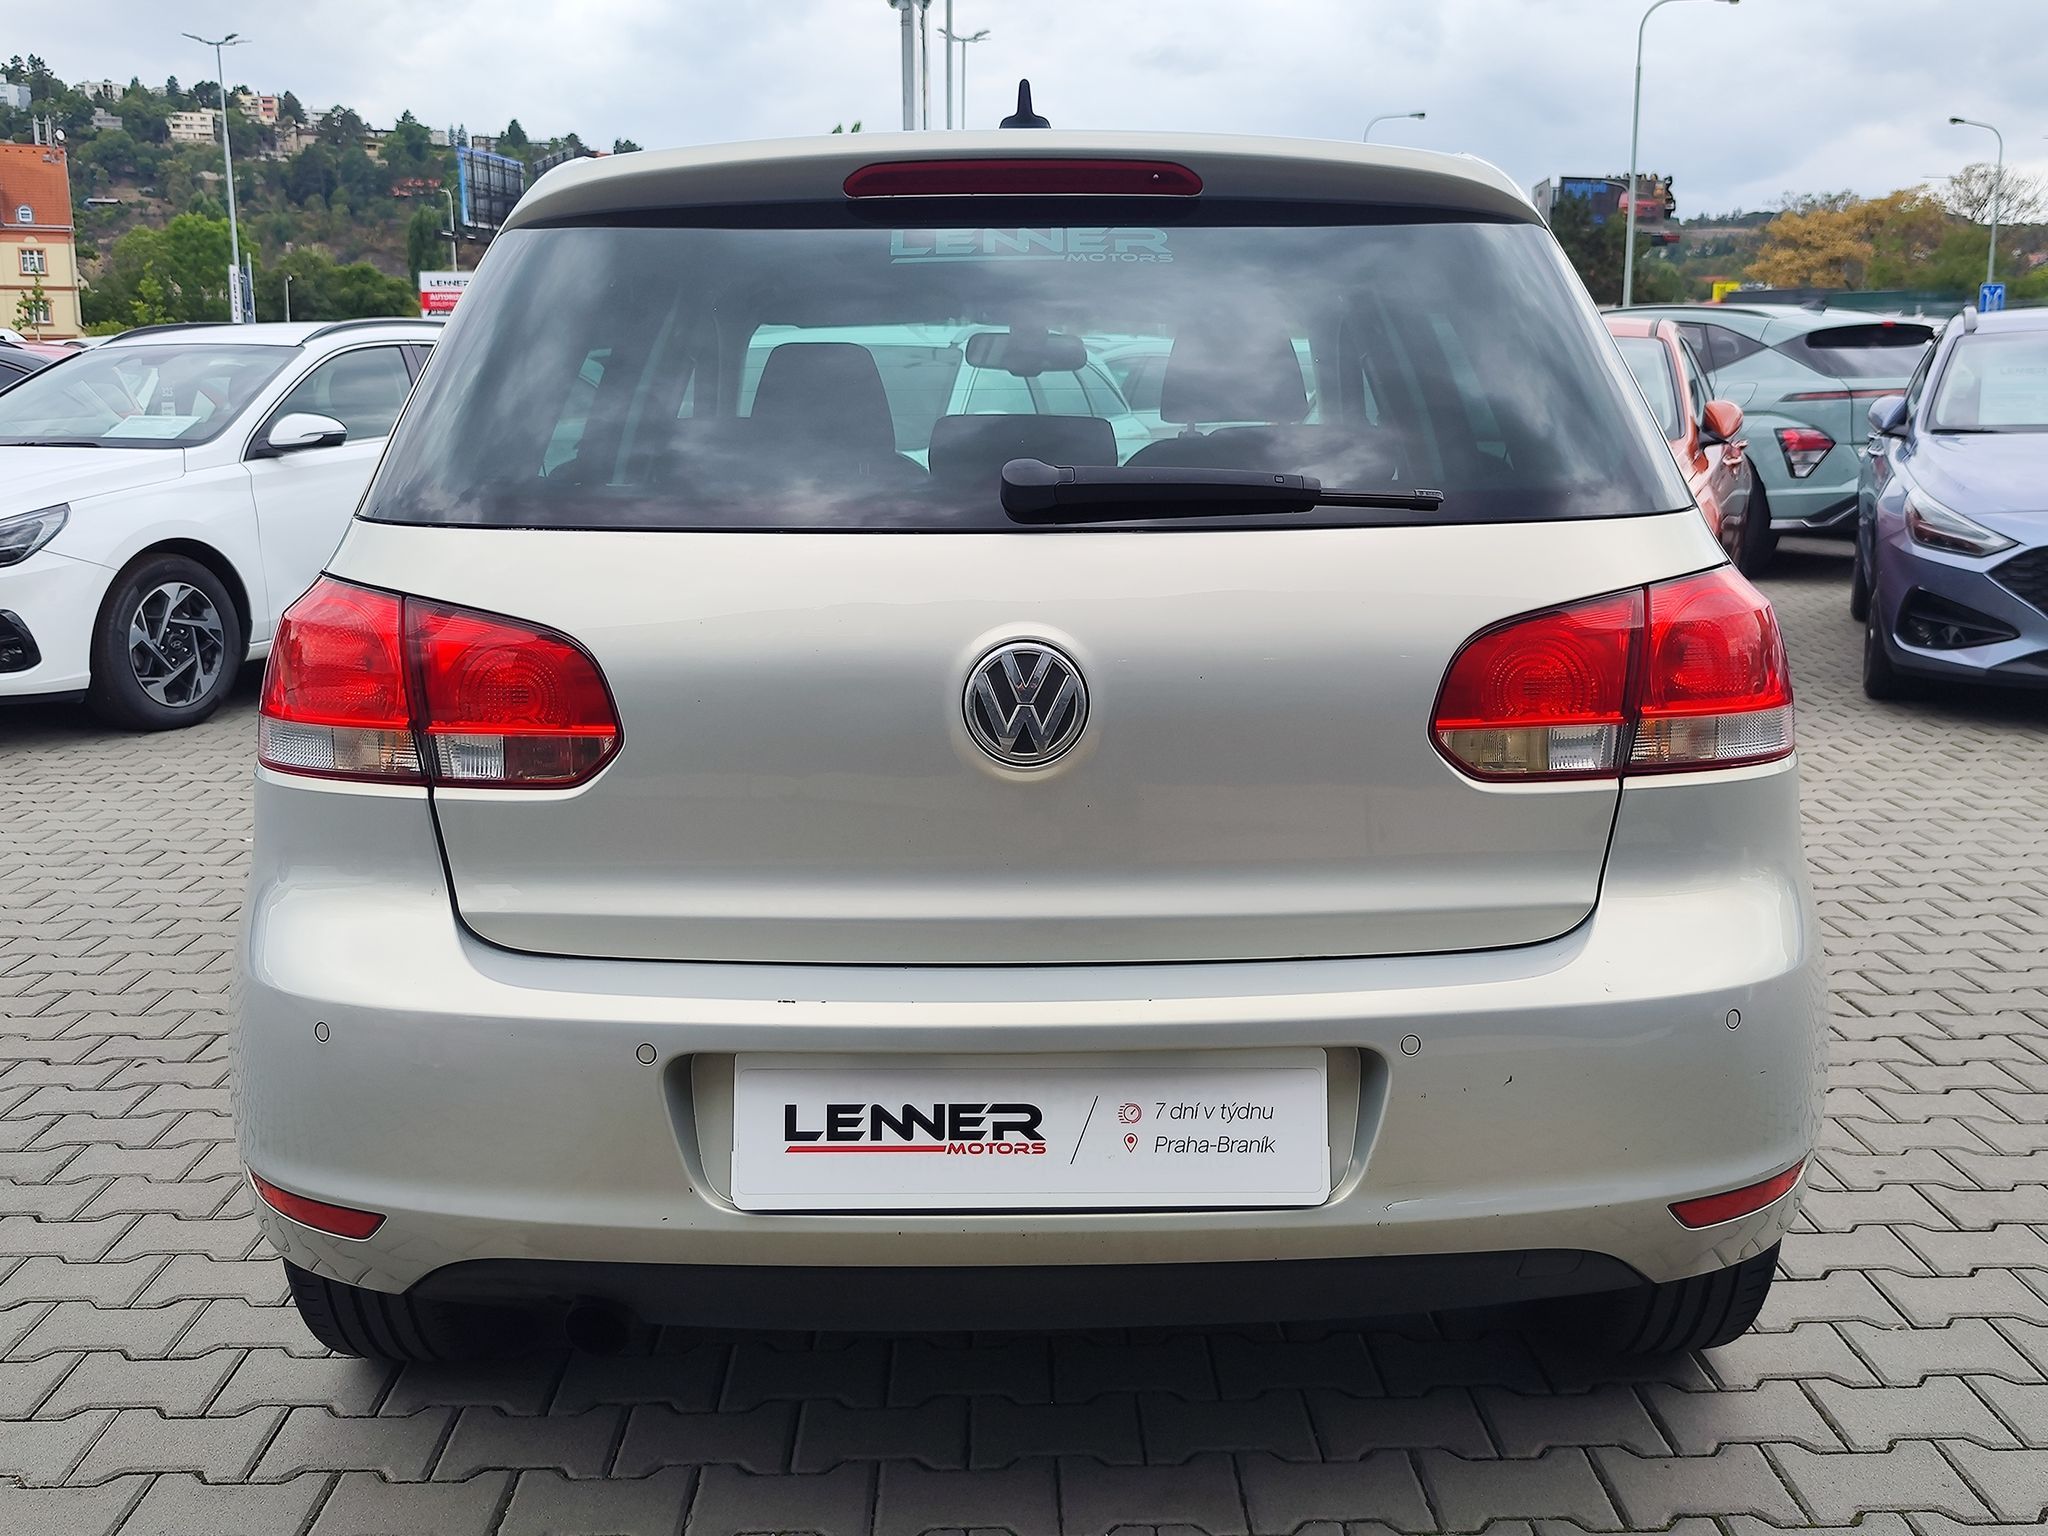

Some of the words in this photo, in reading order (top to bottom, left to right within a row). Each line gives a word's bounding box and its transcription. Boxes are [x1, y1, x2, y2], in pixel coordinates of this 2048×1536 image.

[890, 227, 1172, 256] LENNER
[1066, 252, 1174, 263] MOTORS
[784, 1103, 1046, 1141] LENNER
[1155, 1102, 1166, 1120] 7
[1170, 1102, 1200, 1120] dní
[1203, 1106, 1215, 1120] v
[1220, 1102, 1274, 1124] týdnu
[946, 1142, 1047, 1155] MOTORS
[1154, 1135, 1276, 1153] Praha-Braník
